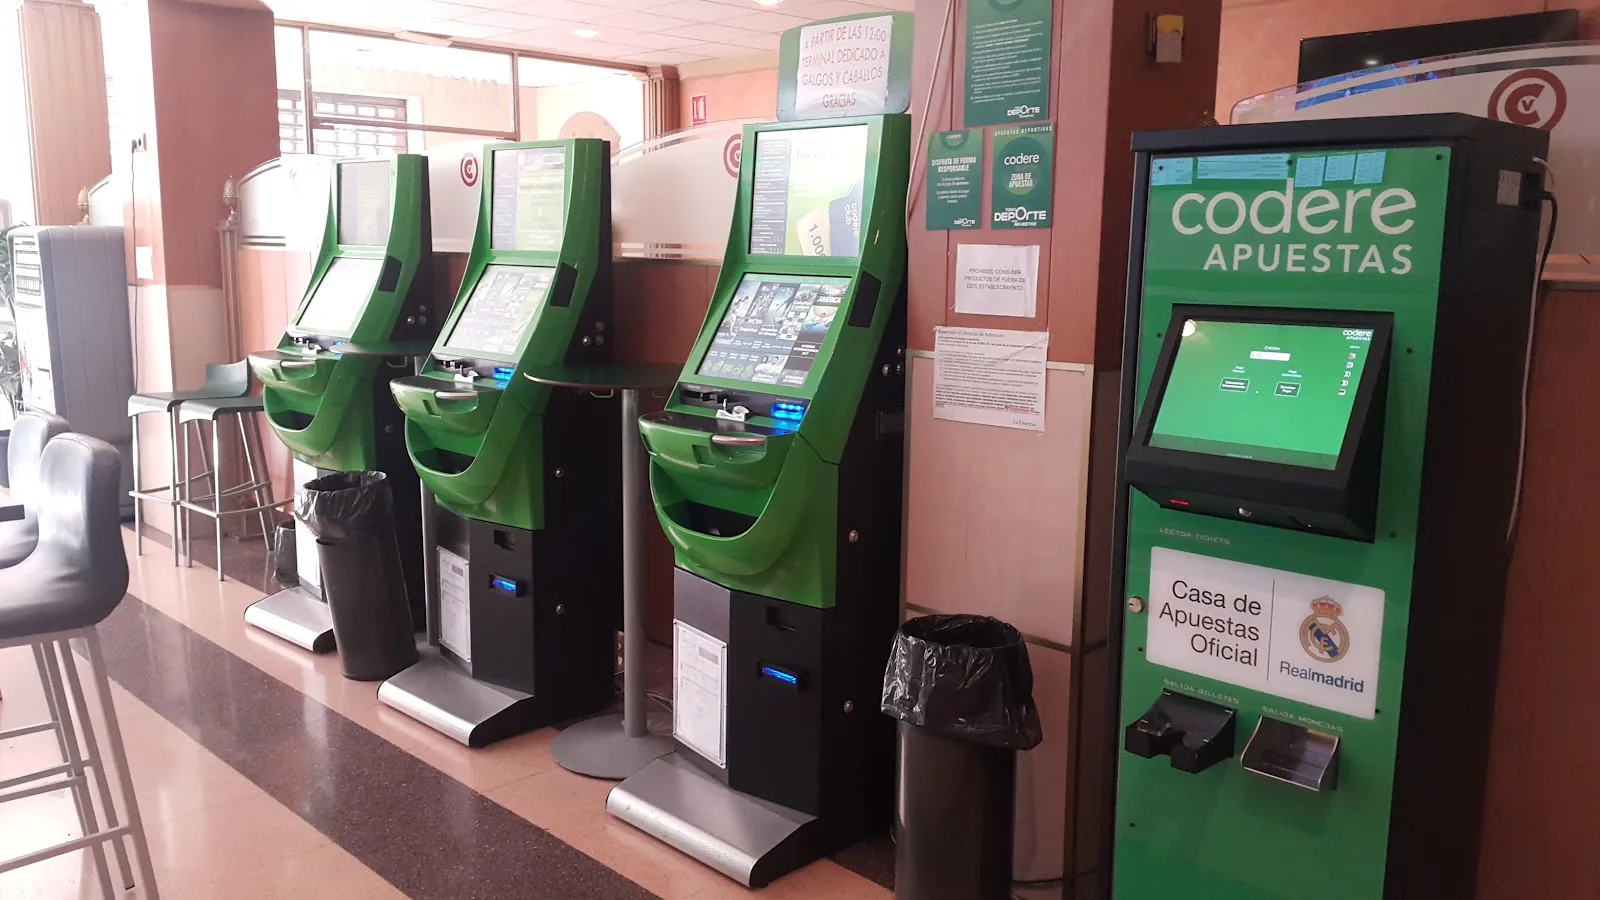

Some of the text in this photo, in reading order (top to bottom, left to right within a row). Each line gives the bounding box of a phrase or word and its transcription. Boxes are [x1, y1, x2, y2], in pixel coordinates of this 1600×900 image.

[804, 25, 887, 51] A PARTIR DE LAS 12:00
[802, 47, 886, 68] TERMINAL DEDICADO A
[802, 66, 883, 86] GALGOS Y CABALLOS
[822, 92, 857, 108] GRACIAS
[931, 156, 977, 167] DISFRUTA DE FORMA
[937, 164, 970, 173] RESPONSABLE
[1004, 153, 1040, 165] codere
[1008, 179, 1033, 188] APUESTAS
[1010, 172, 1032, 181] ZONA DE
[1171, 178, 1417, 235] codere
[1203, 243, 1413, 275] APUESTAS
[1342, 329, 1372, 337] codere
[1172, 580, 1262, 616] Casa de
[1159, 602, 1260, 641] Apuestas
[1190, 633, 1258, 667] Oficial
[1279, 660, 1364, 693] Realmadrid
